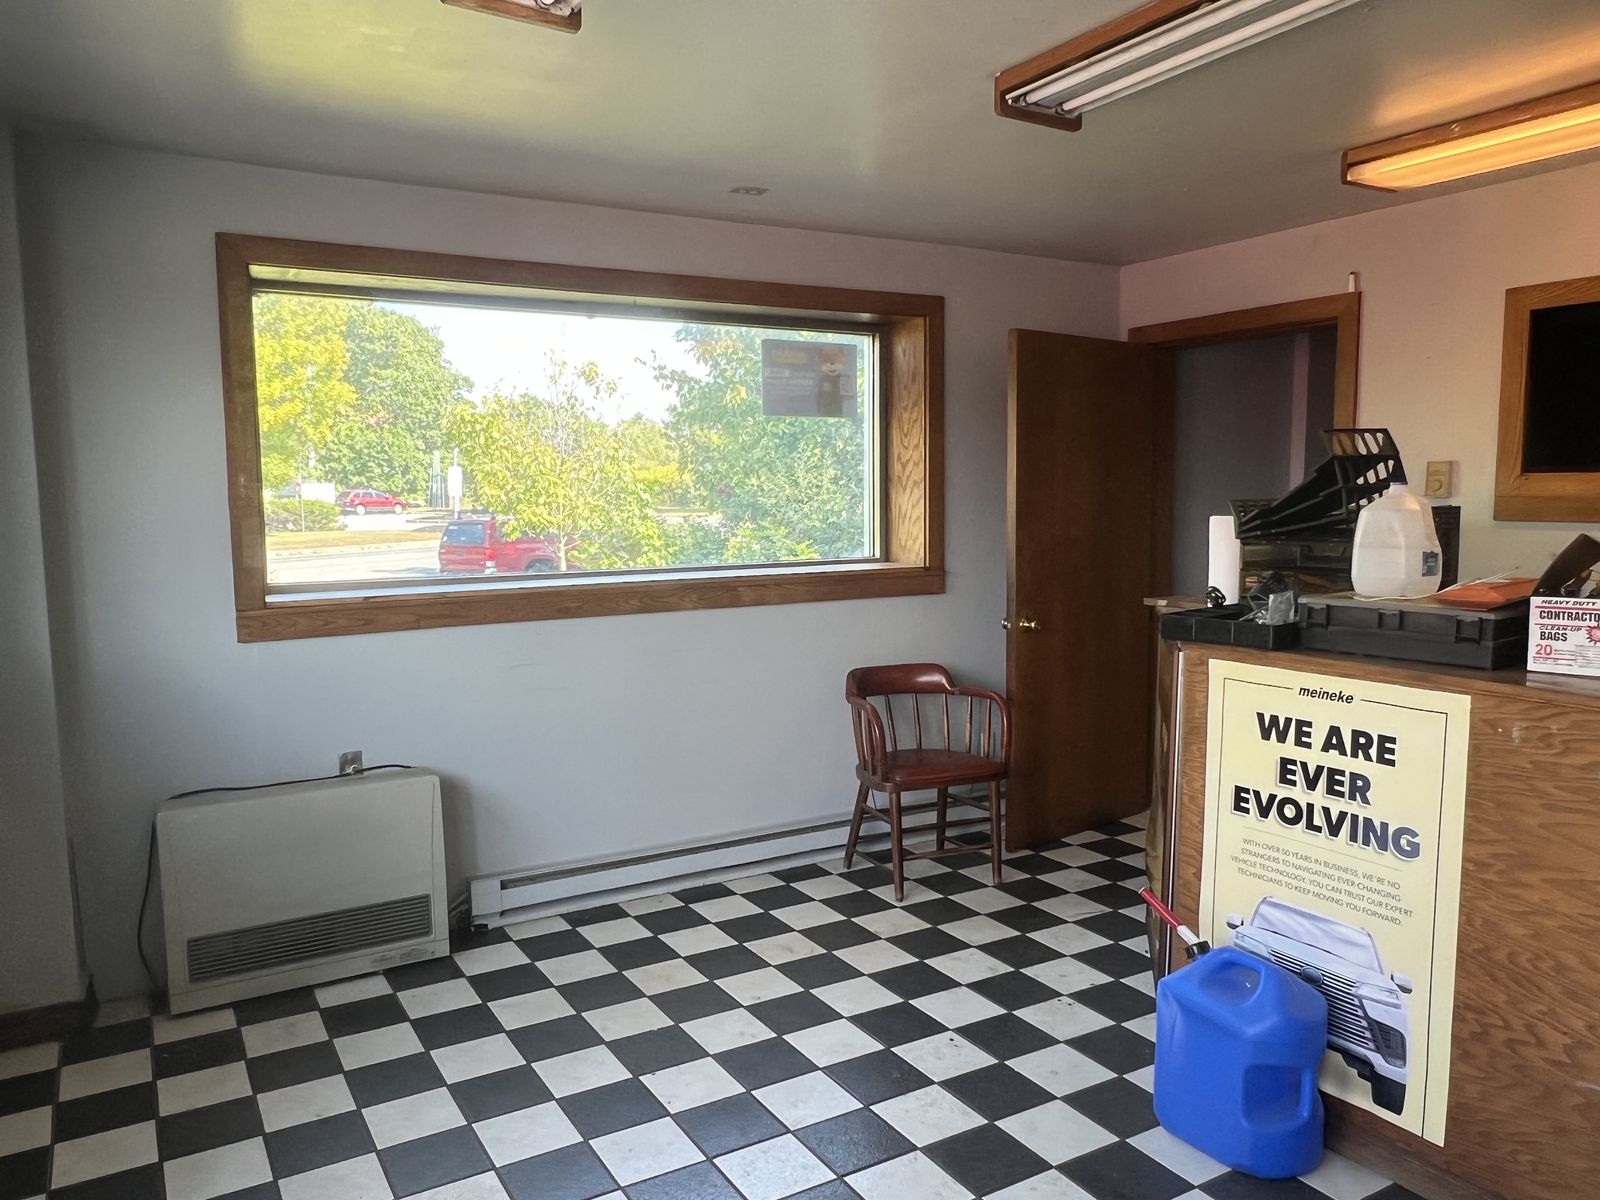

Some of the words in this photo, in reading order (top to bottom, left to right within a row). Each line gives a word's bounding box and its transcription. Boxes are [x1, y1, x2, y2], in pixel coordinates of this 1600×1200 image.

[1535, 644, 1553, 656] 20
[1540, 631, 1568, 642] BAGS
[1298, 687, 1354, 704] meineke
[1256, 711, 1313, 750] WE
[1320, 724, 1397, 768] ARE
[1278, 756, 1372, 806] EVER
[1232, 784, 1421, 860] EVOLVING
[1231, 855, 1257, 868] VEHICLE
[1308, 878, 1324, 889] YOU
[1325, 884, 1342, 894] CAN
[1344, 888, 1365, 902] TRUST
[1366, 897, 1383, 908] OUR
[1384, 903, 1413, 918] EXPERT
[1238, 867, 1283, 887] TECHNICIANS
[1284, 881, 1293, 890] TO
[1294, 885, 1311, 896] KEEP
[1312, 890, 1344, 906] MOVING
[1345, 901, 1361, 912] YOU
[1240, 848, 1280, 864] STRANGERS
[1282, 859, 1291, 867] TO
[1292, 862, 1336, 881] NAVIGATING
[1337, 876, 1401, 902] EVER-CHANGING
[1242, 838, 1260, 848] WITH
[1261, 843, 1280, 854] OVER
[1281, 848, 1290, 856] 50
[1291, 851, 1313, 863] YEARS
[1314, 858, 1322, 866] IN
[1362, 872, 1385, 885] WE'RE
[1387, 880, 1401, 890] NO
